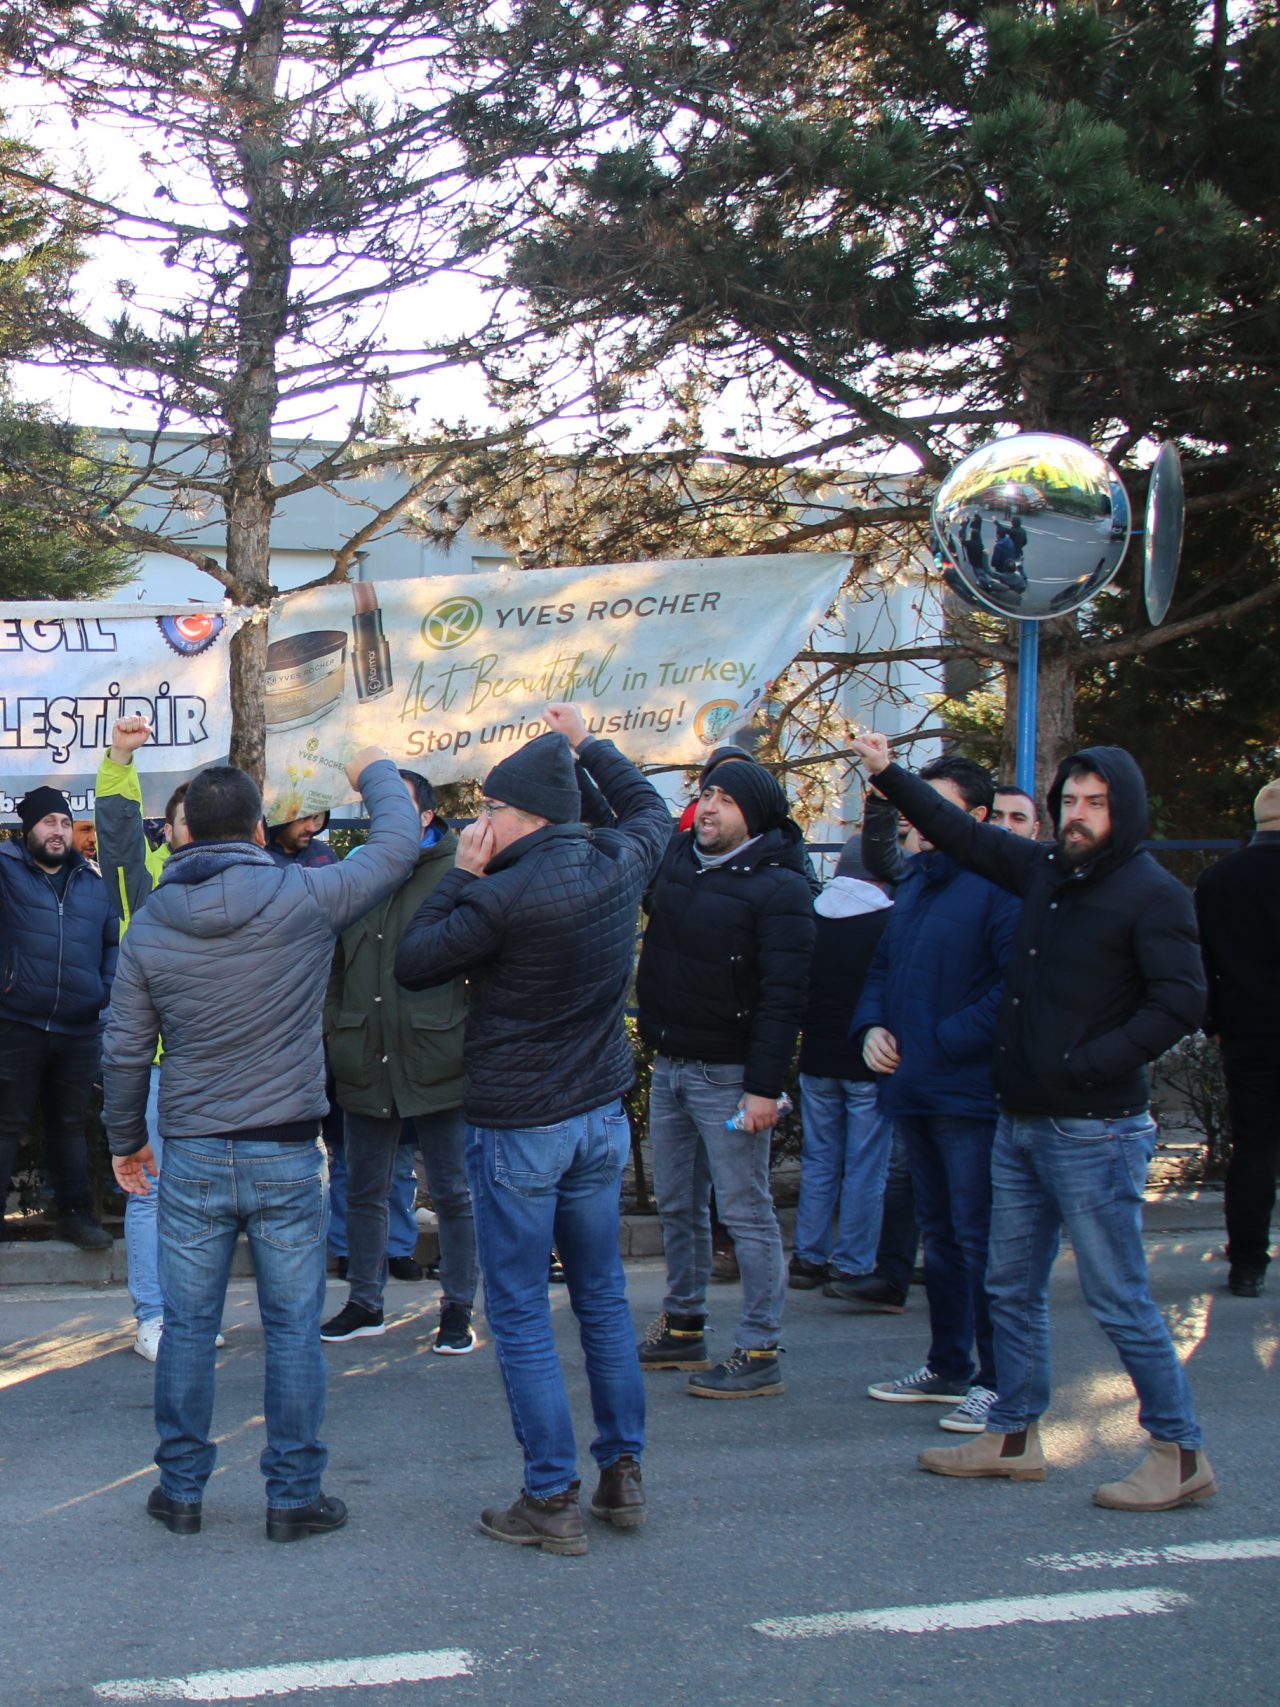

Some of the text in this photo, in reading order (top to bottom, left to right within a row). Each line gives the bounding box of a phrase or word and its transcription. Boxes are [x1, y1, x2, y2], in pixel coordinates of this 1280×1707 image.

[496, 591, 721, 628] YVES ROCHER
[279, 658, 335, 682] YVES ROCHER
[398, 643, 757, 723] Act Beautiful in Turkey.
[405, 700, 686, 756] Stop unio usting!
[299, 750, 318, 761] YVES
